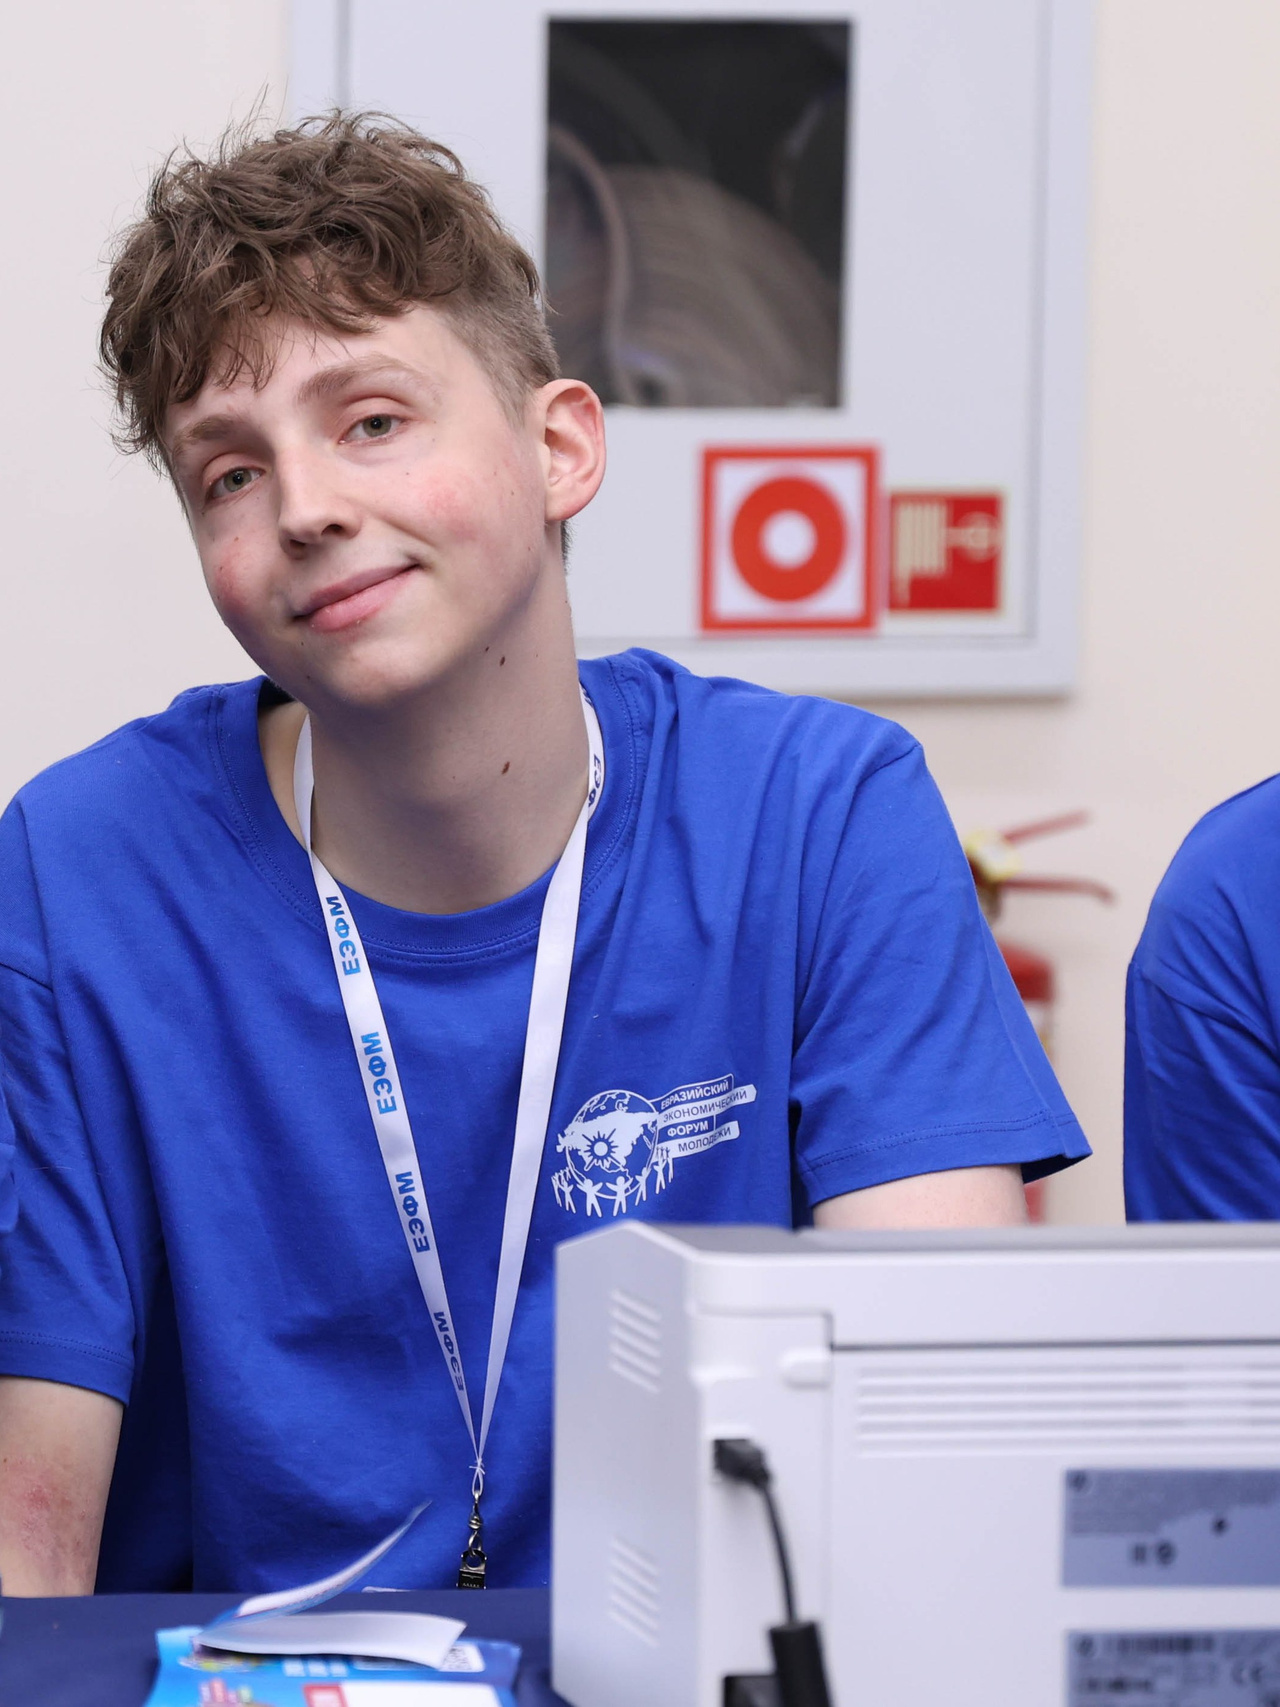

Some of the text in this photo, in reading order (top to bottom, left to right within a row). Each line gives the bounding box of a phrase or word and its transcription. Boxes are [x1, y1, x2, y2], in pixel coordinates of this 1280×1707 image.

[588, 753, 602, 807] ЕЭФ
[326, 895, 360, 976] ЕЭФМ
[360, 1031, 397, 1115] ЕЭФМ
[661, 1080, 729, 1108] ЕВРАЗИЙСКИЙ
[663, 1089, 747, 1123] ЭКОНОМИЧЕСКИЙ
[668, 1120, 709, 1137] ФОРУМ
[677, 1126, 732, 1152] МОЛОДЕЖИ
[395, 1171, 430, 1253] ЕЭФМ
[433, 1311, 464, 1391] ЕЭФМ
